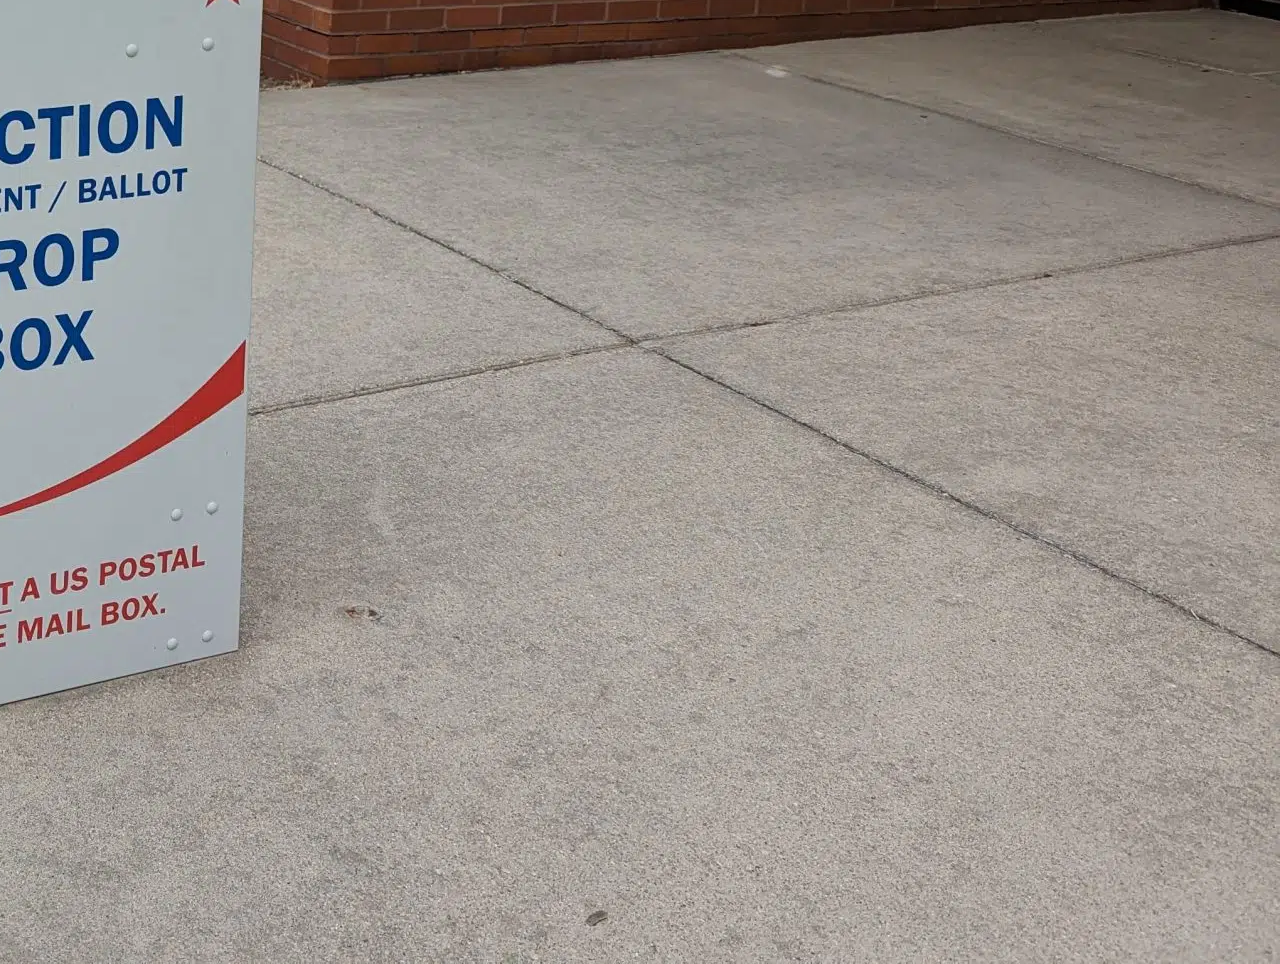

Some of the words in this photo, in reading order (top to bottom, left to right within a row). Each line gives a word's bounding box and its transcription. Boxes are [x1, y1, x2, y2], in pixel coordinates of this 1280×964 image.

[48, 181, 67, 213] /
[78, 168, 189, 204] BALLOT
[20, 577, 41, 603] A
[50, 566, 89, 596] US
[99, 545, 206, 586] POSTAL
[17, 608, 91, 644] MAIL
[100, 592, 167, 627] BOX.
